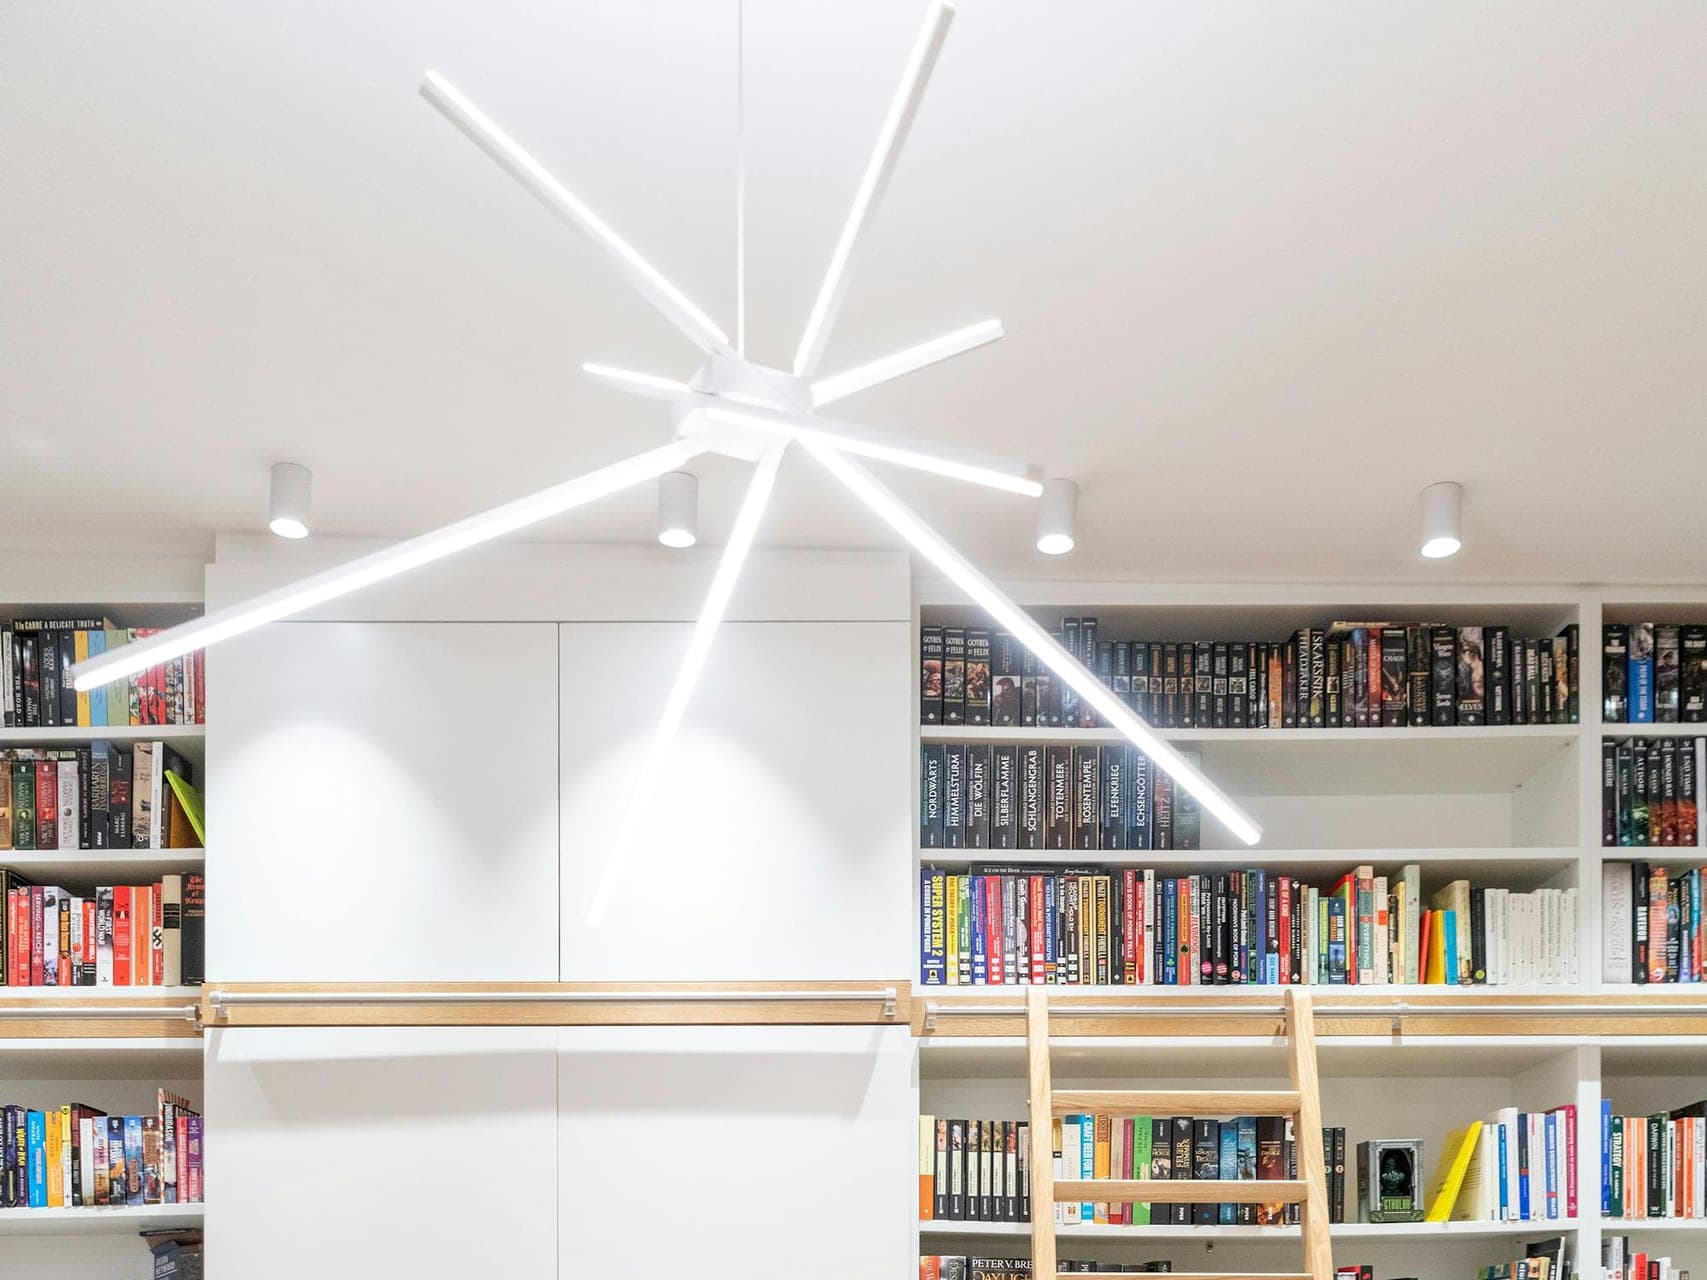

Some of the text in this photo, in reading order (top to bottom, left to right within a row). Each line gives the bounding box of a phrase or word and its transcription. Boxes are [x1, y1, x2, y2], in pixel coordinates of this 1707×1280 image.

[1311, 636, 1324, 698] SKARSNIK
[928, 759, 938, 818] NORDWÄRTS
[950, 754, 960, 827] HIMMELSTURM
[972, 763, 983, 817] DIE WÖLFIN
[1000, 755, 1010, 827] SILBERFLAMME
[1028, 750, 1037, 832] SCHLANGENGRAB
[1056, 762, 1065, 820] TOTENMEER
[1082, 759, 1092, 823] ROSENTEMPEL
[1110, 764, 1120, 817] ELFENKRIEG
[1160, 797, 1171, 828] HEITZ
[932, 876, 943, 907] SUPER
[1281, 880, 1289, 889] ONE
[1281, 890, 1289, 898] OF
[115, 910, 129, 919] WAR
[932, 909, 943, 948] SYSTEM
[1281, 904, 1289, 917] KIND
[1612, 1132, 1622, 1168] STRATEGY
[1651, 1123, 1660, 1150] DARWIN
[972, 1259, 1033, 1269] PETER V. BRE
